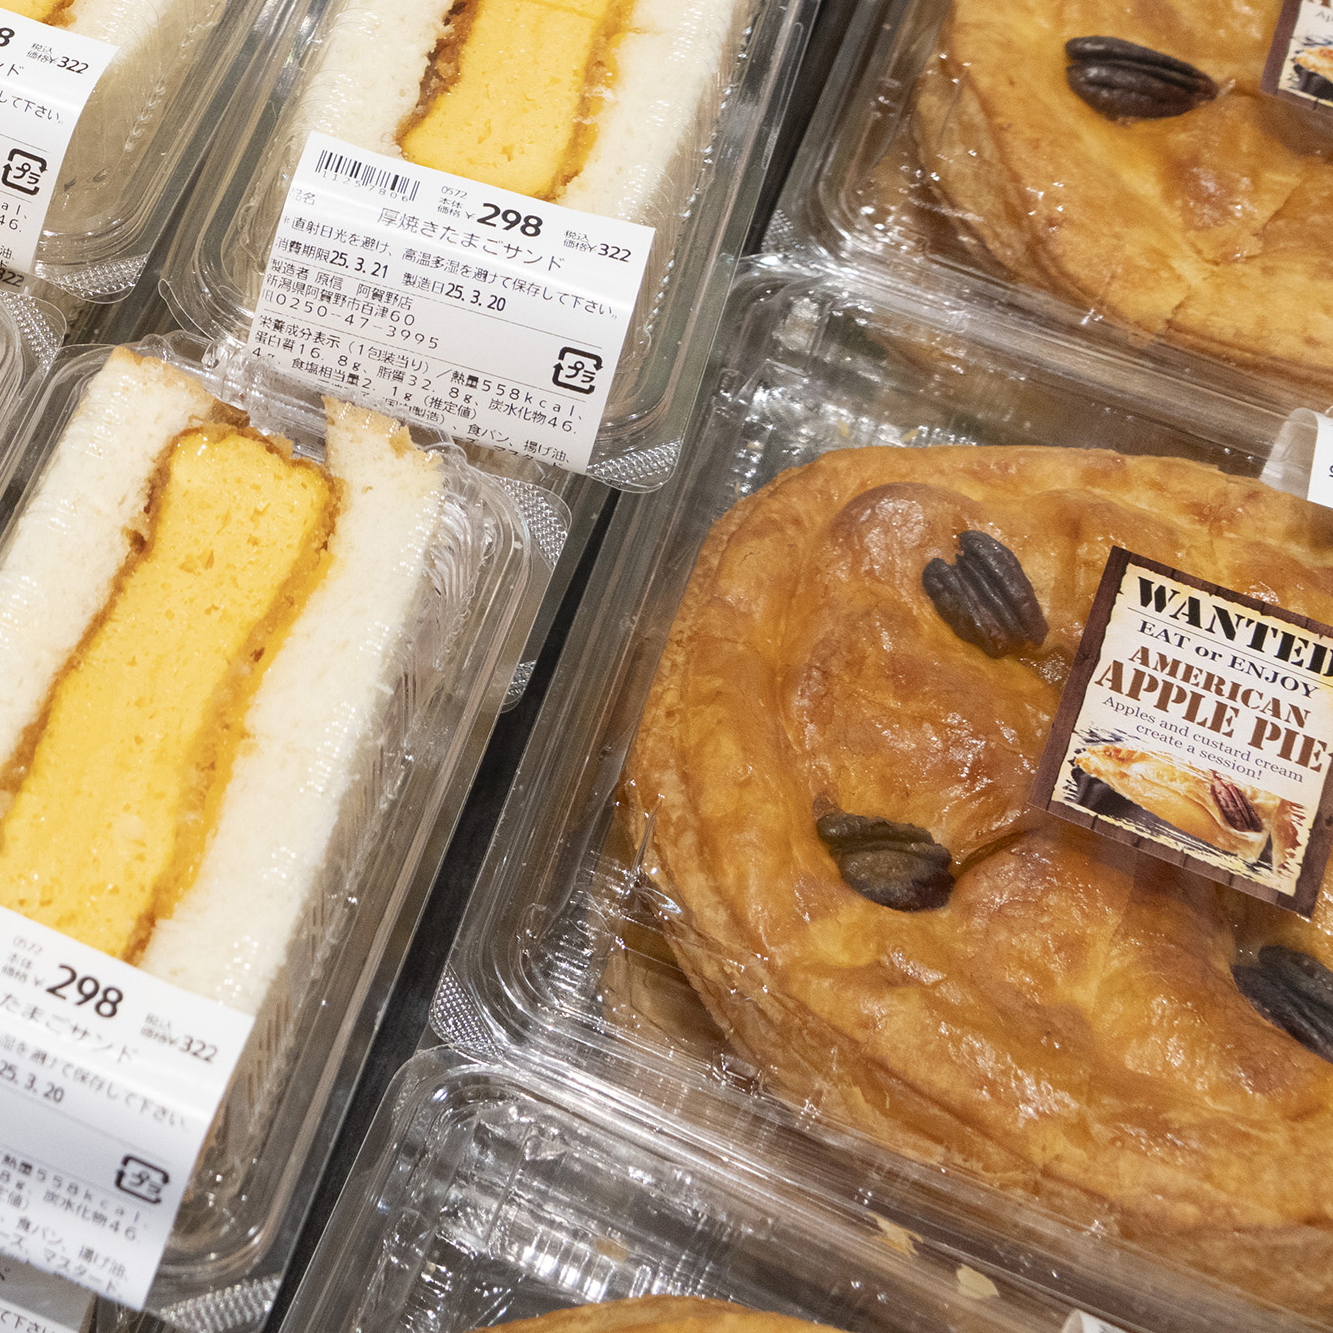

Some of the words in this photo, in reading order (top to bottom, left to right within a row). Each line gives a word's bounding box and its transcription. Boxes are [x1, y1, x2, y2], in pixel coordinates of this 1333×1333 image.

[57, 54, 89, 75] 322
[376, 206, 565, 273] 厚焼きたまごサンド
[476, 201, 544, 239] 298
[597, 242, 632, 263] 322
[1128, 645, 1312, 728] AMERICAN
[1138, 619, 1191, 649] EAT
[1194, 645, 1224, 664] or
[1228, 655, 1320, 700] ENJOY
[1094, 660, 1240, 738] APPLE
[1247, 715, 1333, 773] PIE
[1103, 696, 1156, 723] Apples
[1159, 717, 1190, 737] and
[1192, 729, 1252, 763] custard
[1254, 755, 1304, 783] cream
[1135, 722, 1183, 748] create
[1186, 743, 1196, 755] a
[1199, 748, 1263, 781] session!
[46, 963, 125, 1019] 298
[178, 1033, 220, 1064] 322
